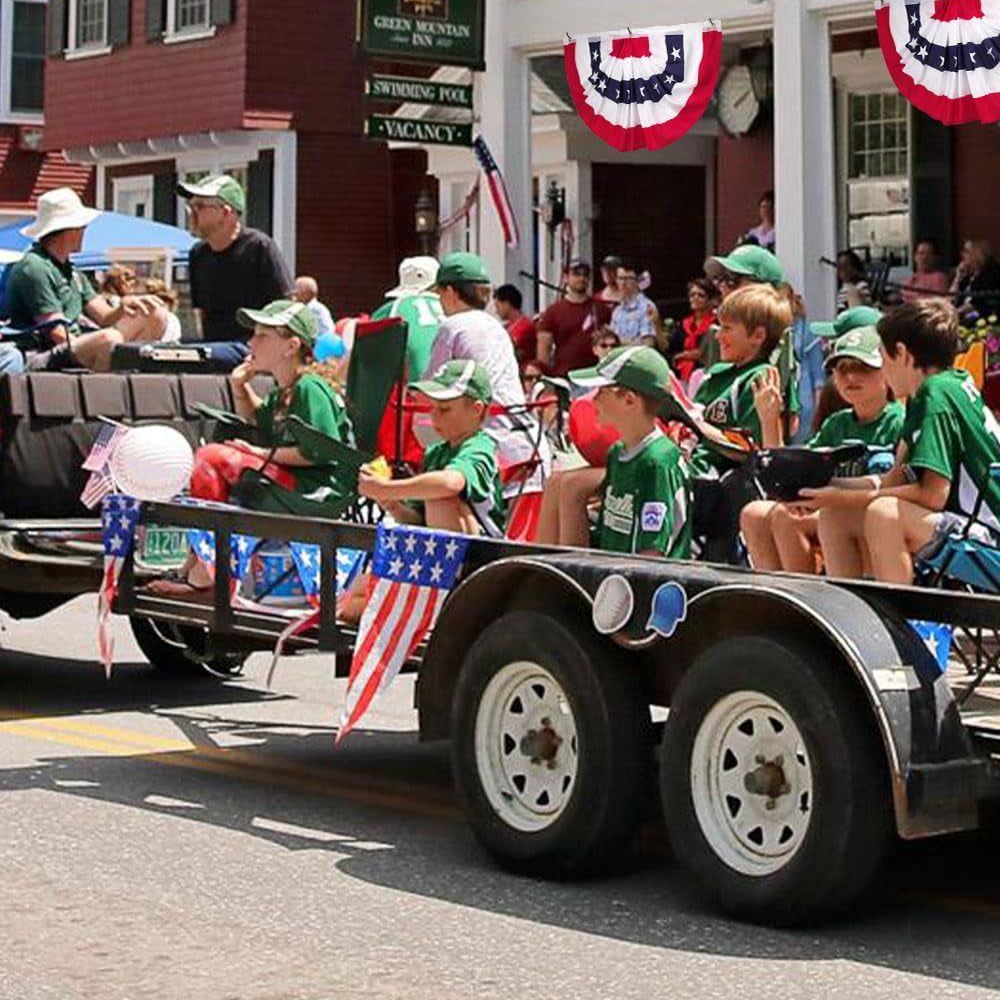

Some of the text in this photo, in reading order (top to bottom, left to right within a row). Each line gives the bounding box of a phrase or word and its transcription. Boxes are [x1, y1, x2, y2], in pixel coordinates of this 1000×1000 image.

[373, 15, 471, 37] GREEN MOUNTAIN
[411, 33, 433, 47] INN
[372, 80, 469, 104] SWIMMING POOL
